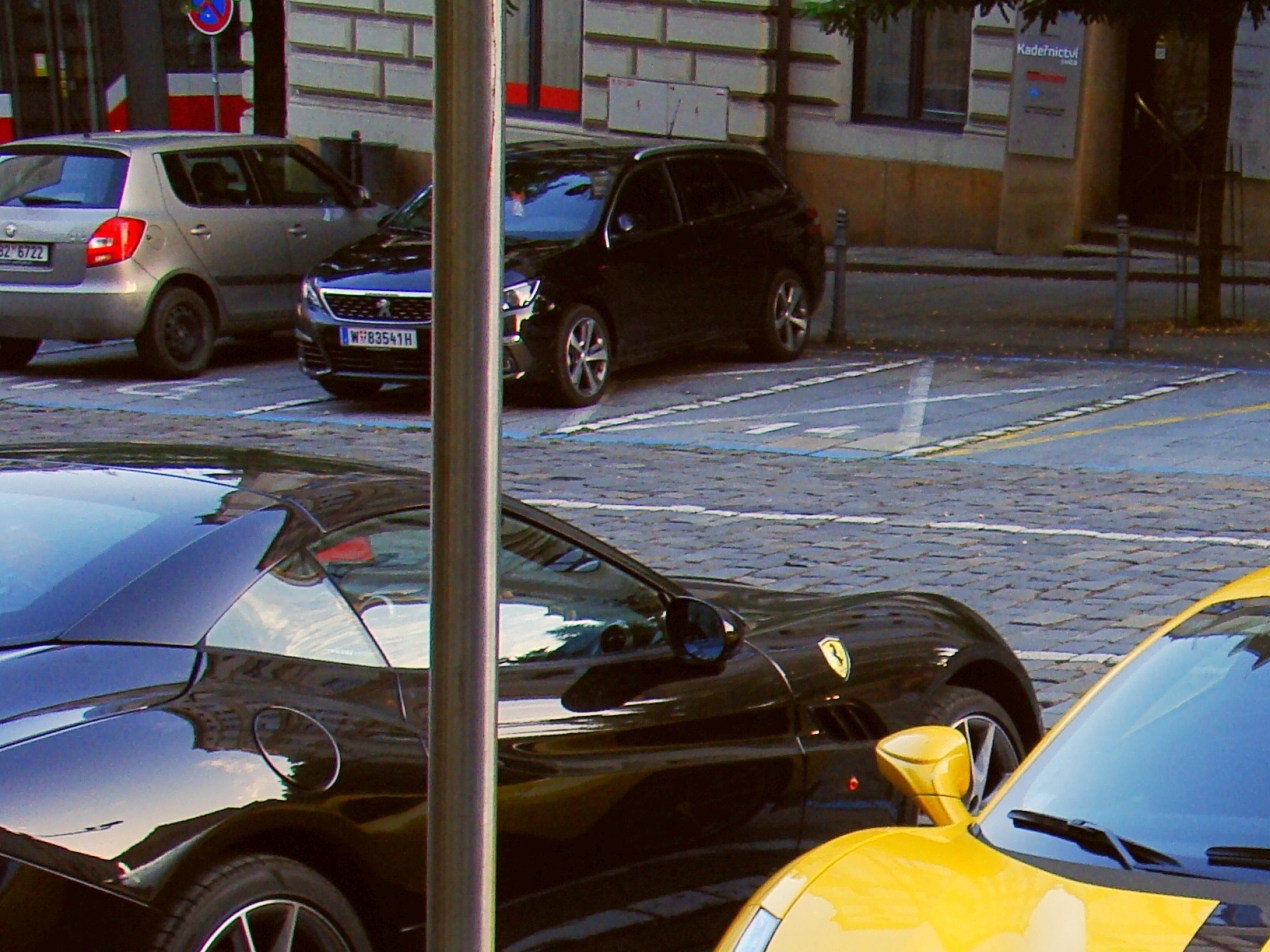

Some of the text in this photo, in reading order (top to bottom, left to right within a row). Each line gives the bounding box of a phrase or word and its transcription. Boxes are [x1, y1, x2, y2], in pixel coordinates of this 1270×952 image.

[1017, 43, 1079, 58] Kadeřnictví
[18, 245, 43, 260] 6722
[367, 331, 412, 346] 83541H
